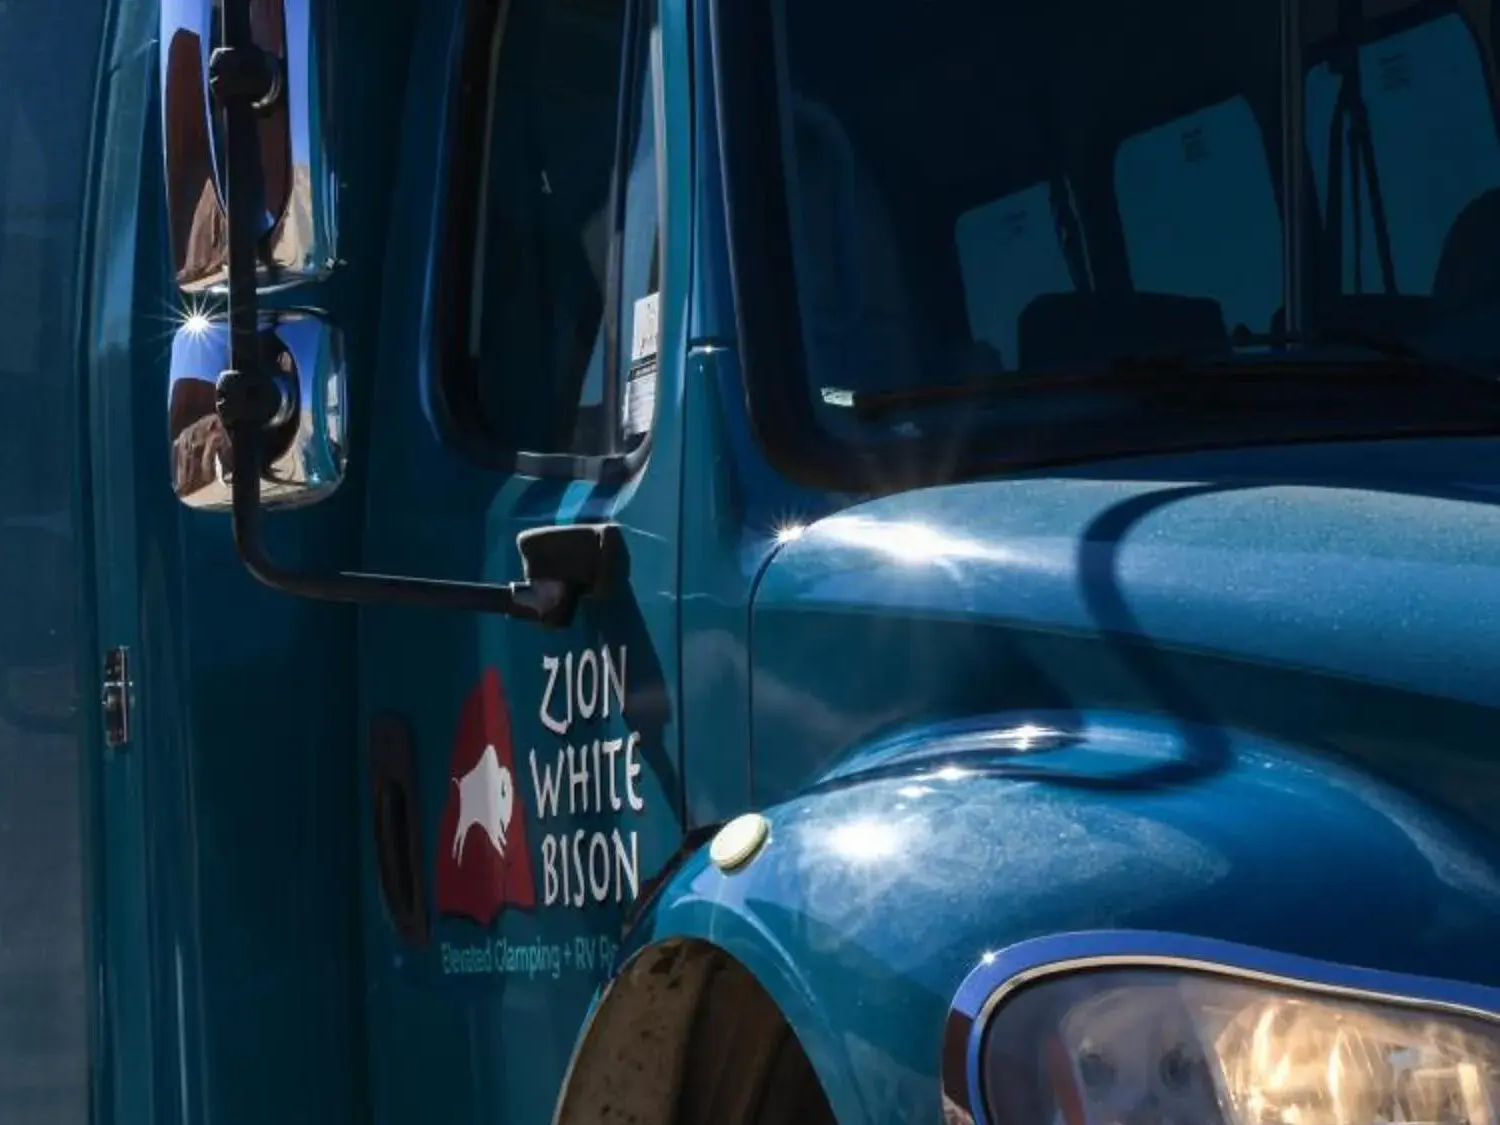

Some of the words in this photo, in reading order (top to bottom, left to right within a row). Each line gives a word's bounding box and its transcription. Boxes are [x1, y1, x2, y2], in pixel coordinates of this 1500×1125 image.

[539, 645, 627, 734] ZION
[529, 731, 643, 819] WHITE
[541, 829, 640, 908] BISON
[574, 935, 596, 971] RV
